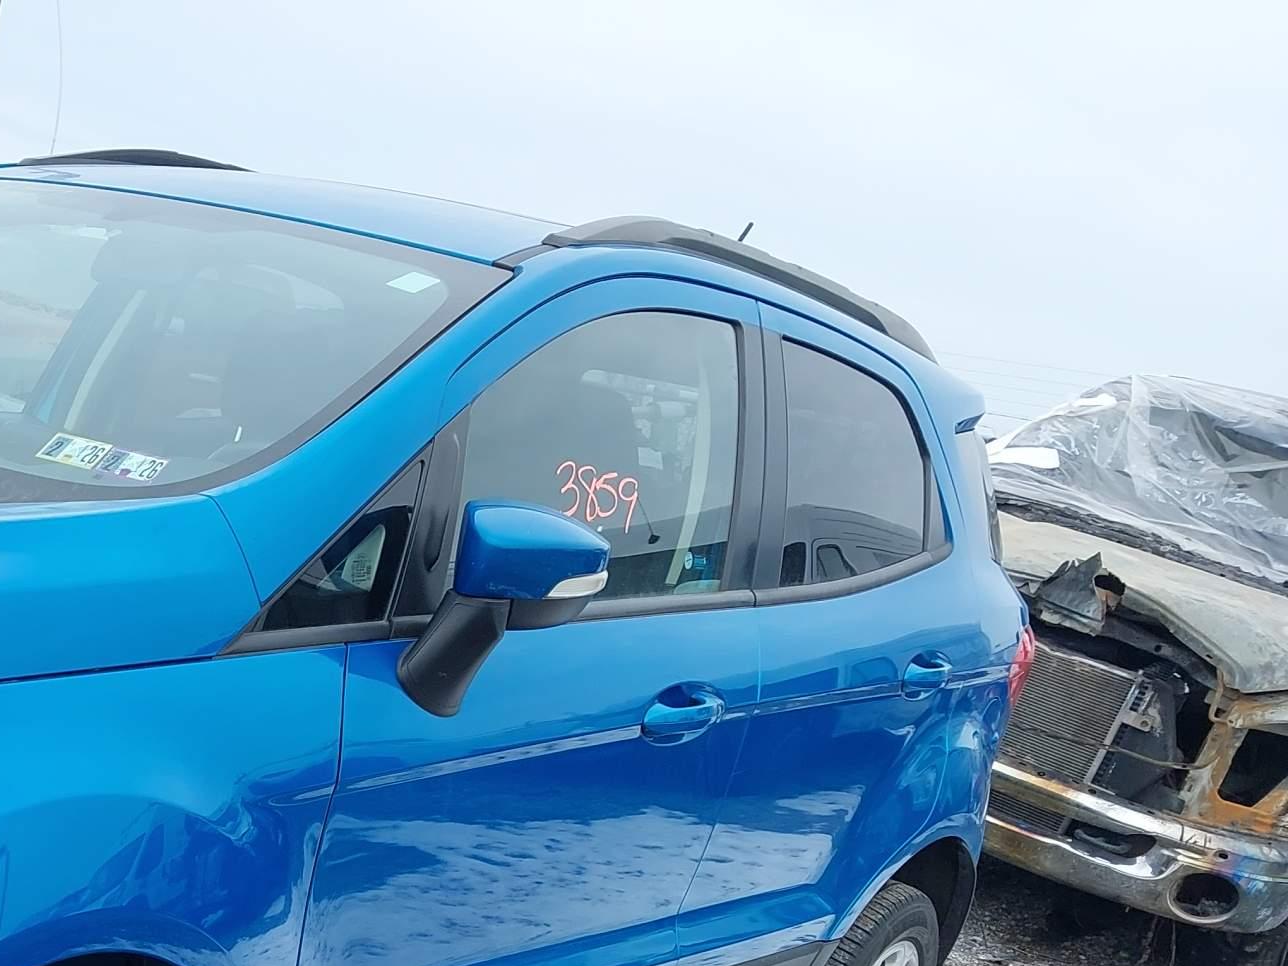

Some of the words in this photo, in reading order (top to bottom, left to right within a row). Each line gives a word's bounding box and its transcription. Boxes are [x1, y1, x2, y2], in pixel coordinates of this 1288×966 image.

[45, 441, 64, 456] 2
[80, 445, 105, 464] 26
[103, 455, 122, 472] 2
[138, 459, 163, 479] 26
[556, 460, 639, 534] 3859
